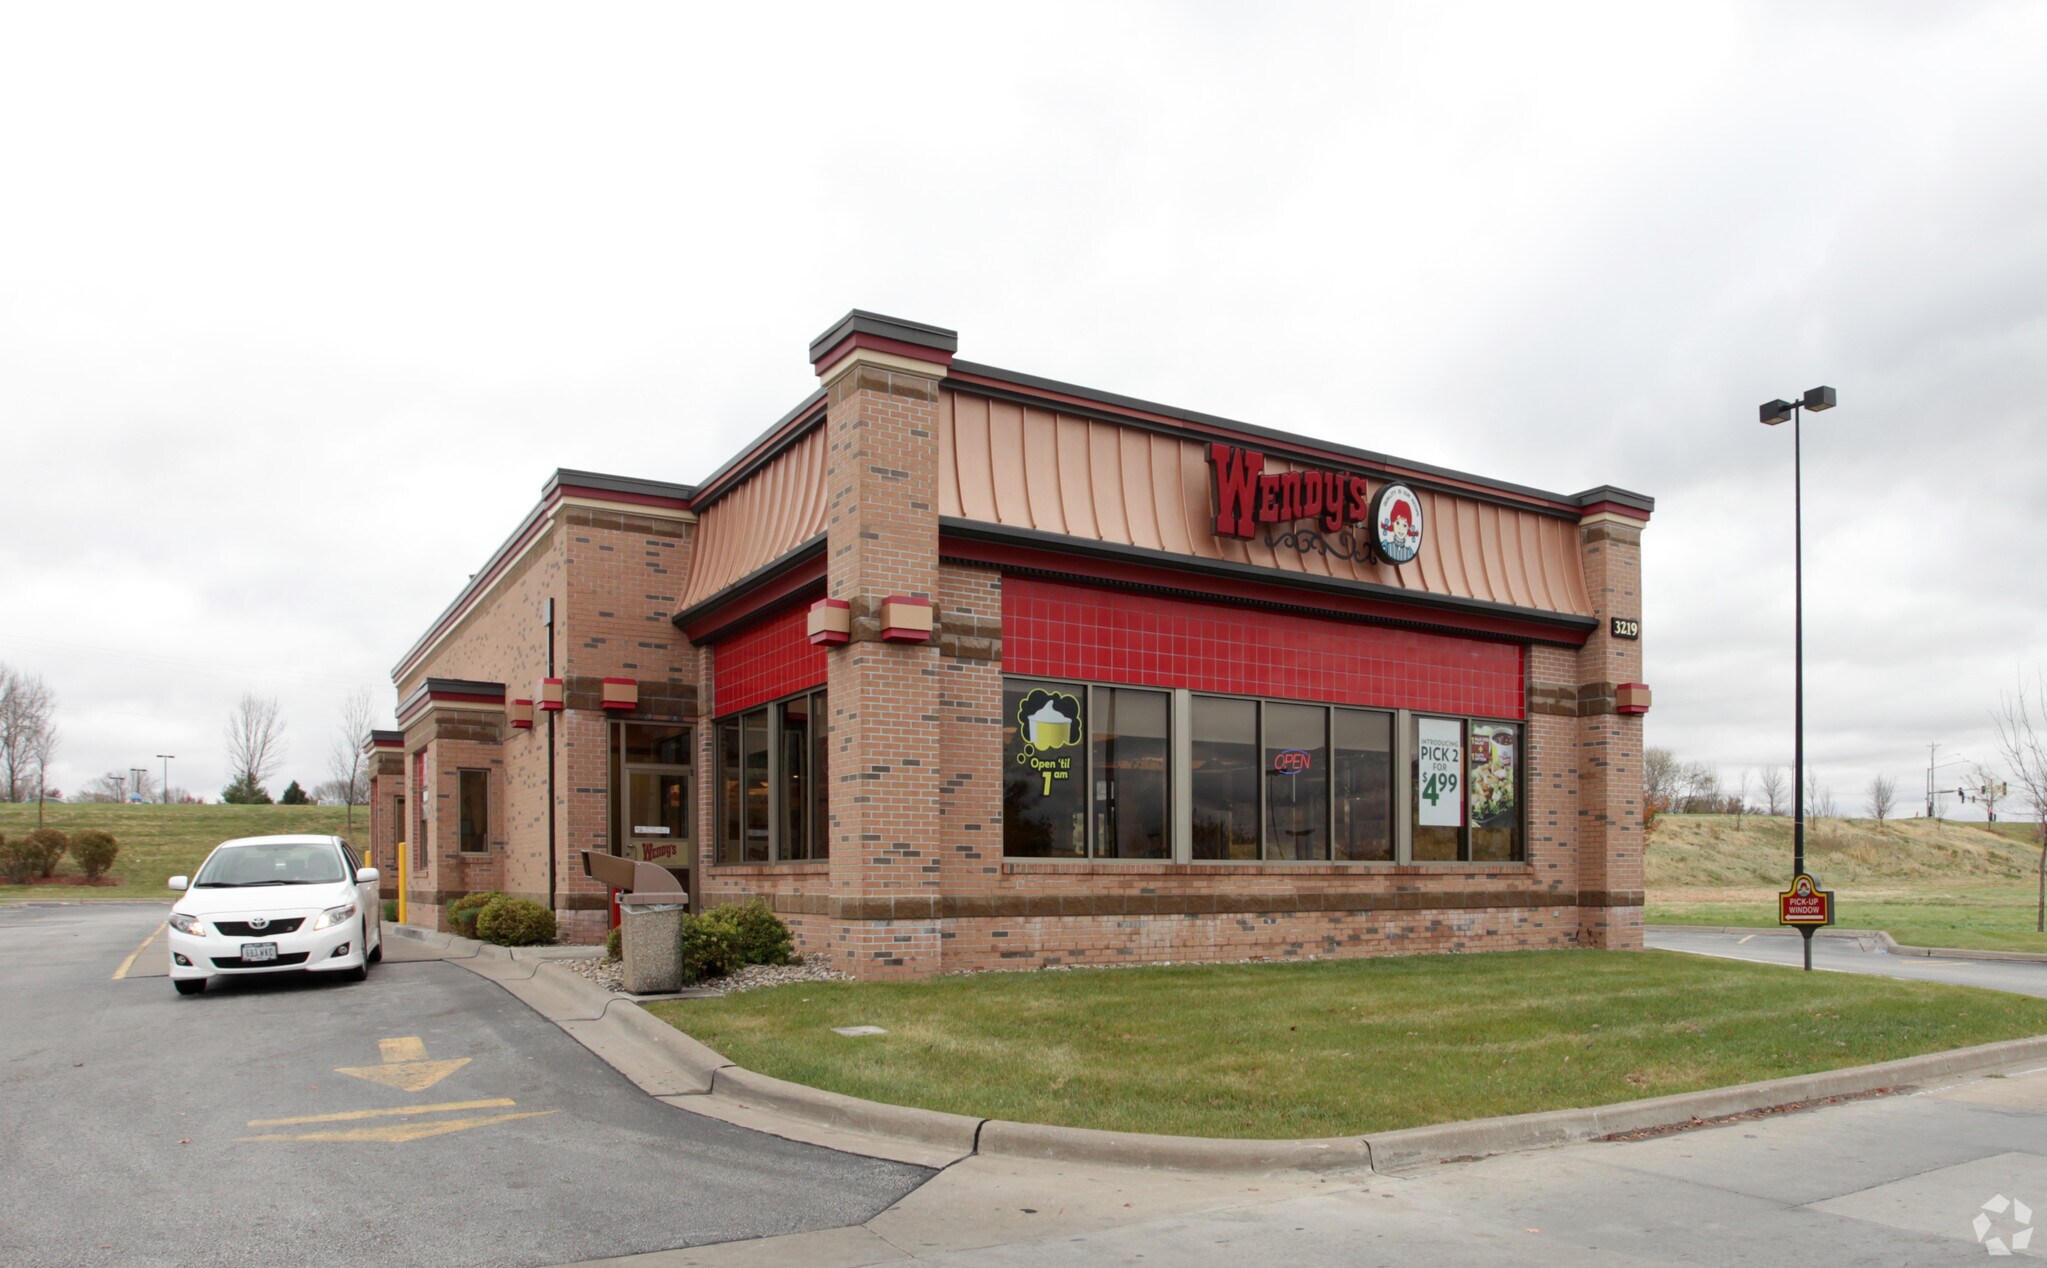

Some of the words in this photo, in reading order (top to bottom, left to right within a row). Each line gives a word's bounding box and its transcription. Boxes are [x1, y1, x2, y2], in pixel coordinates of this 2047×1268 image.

[1614, 620, 1638, 636] 3219
[1421, 739, 1459, 748] INTRODUCING
[1274, 753, 1311, 770] OPEN
[1421, 746, 1450, 762] PICK
[1452, 749, 1459, 763] 2
[1030, 757, 1056, 771] Open
[1432, 763, 1447, 771] FOR
[1042, 771, 1052, 796] 1
[1054, 771, 1068, 779] am
[1789, 898, 1819, 906] PICK-UP
[1789, 906, 1820, 914] WINDOW
